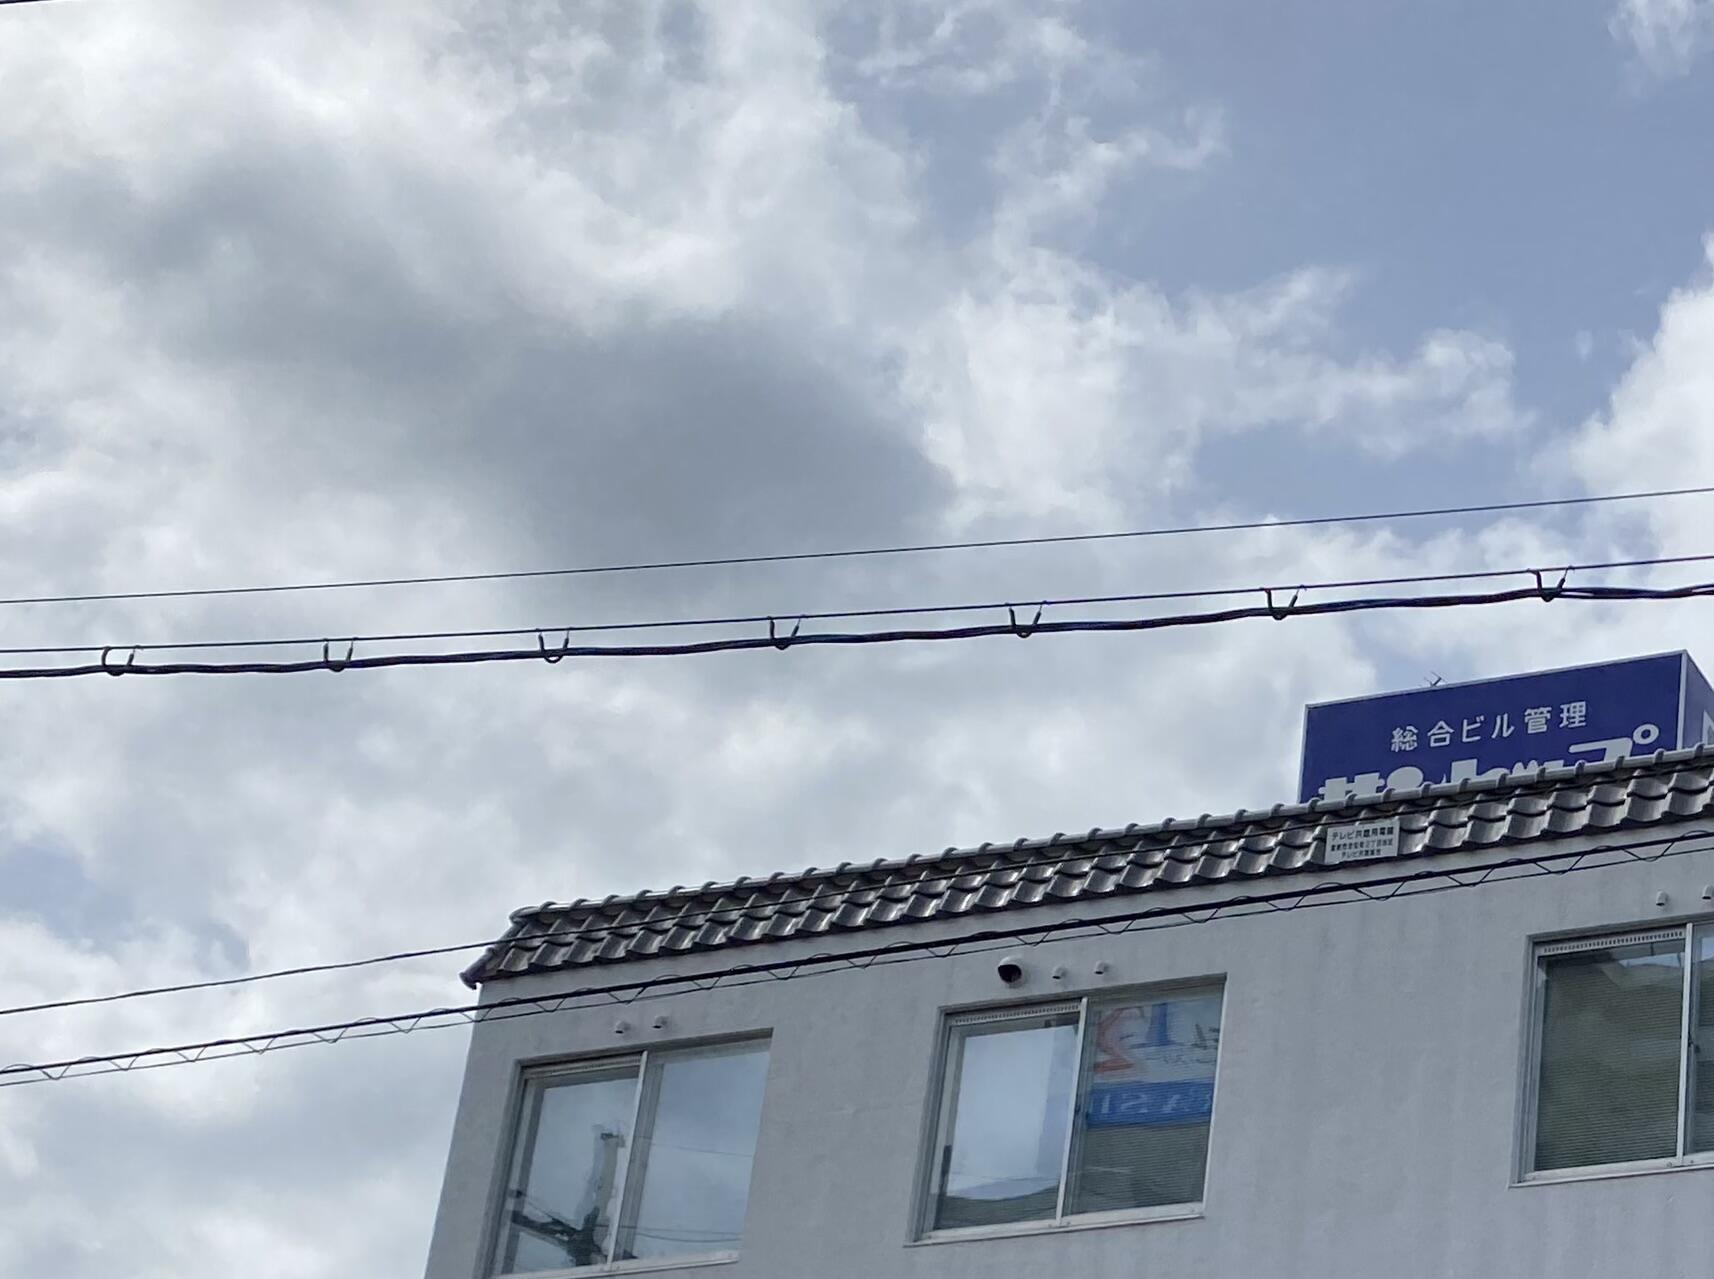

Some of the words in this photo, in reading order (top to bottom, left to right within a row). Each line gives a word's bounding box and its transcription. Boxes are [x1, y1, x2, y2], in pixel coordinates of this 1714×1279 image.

[1391, 701, 1587, 752] 総合ビル管理
